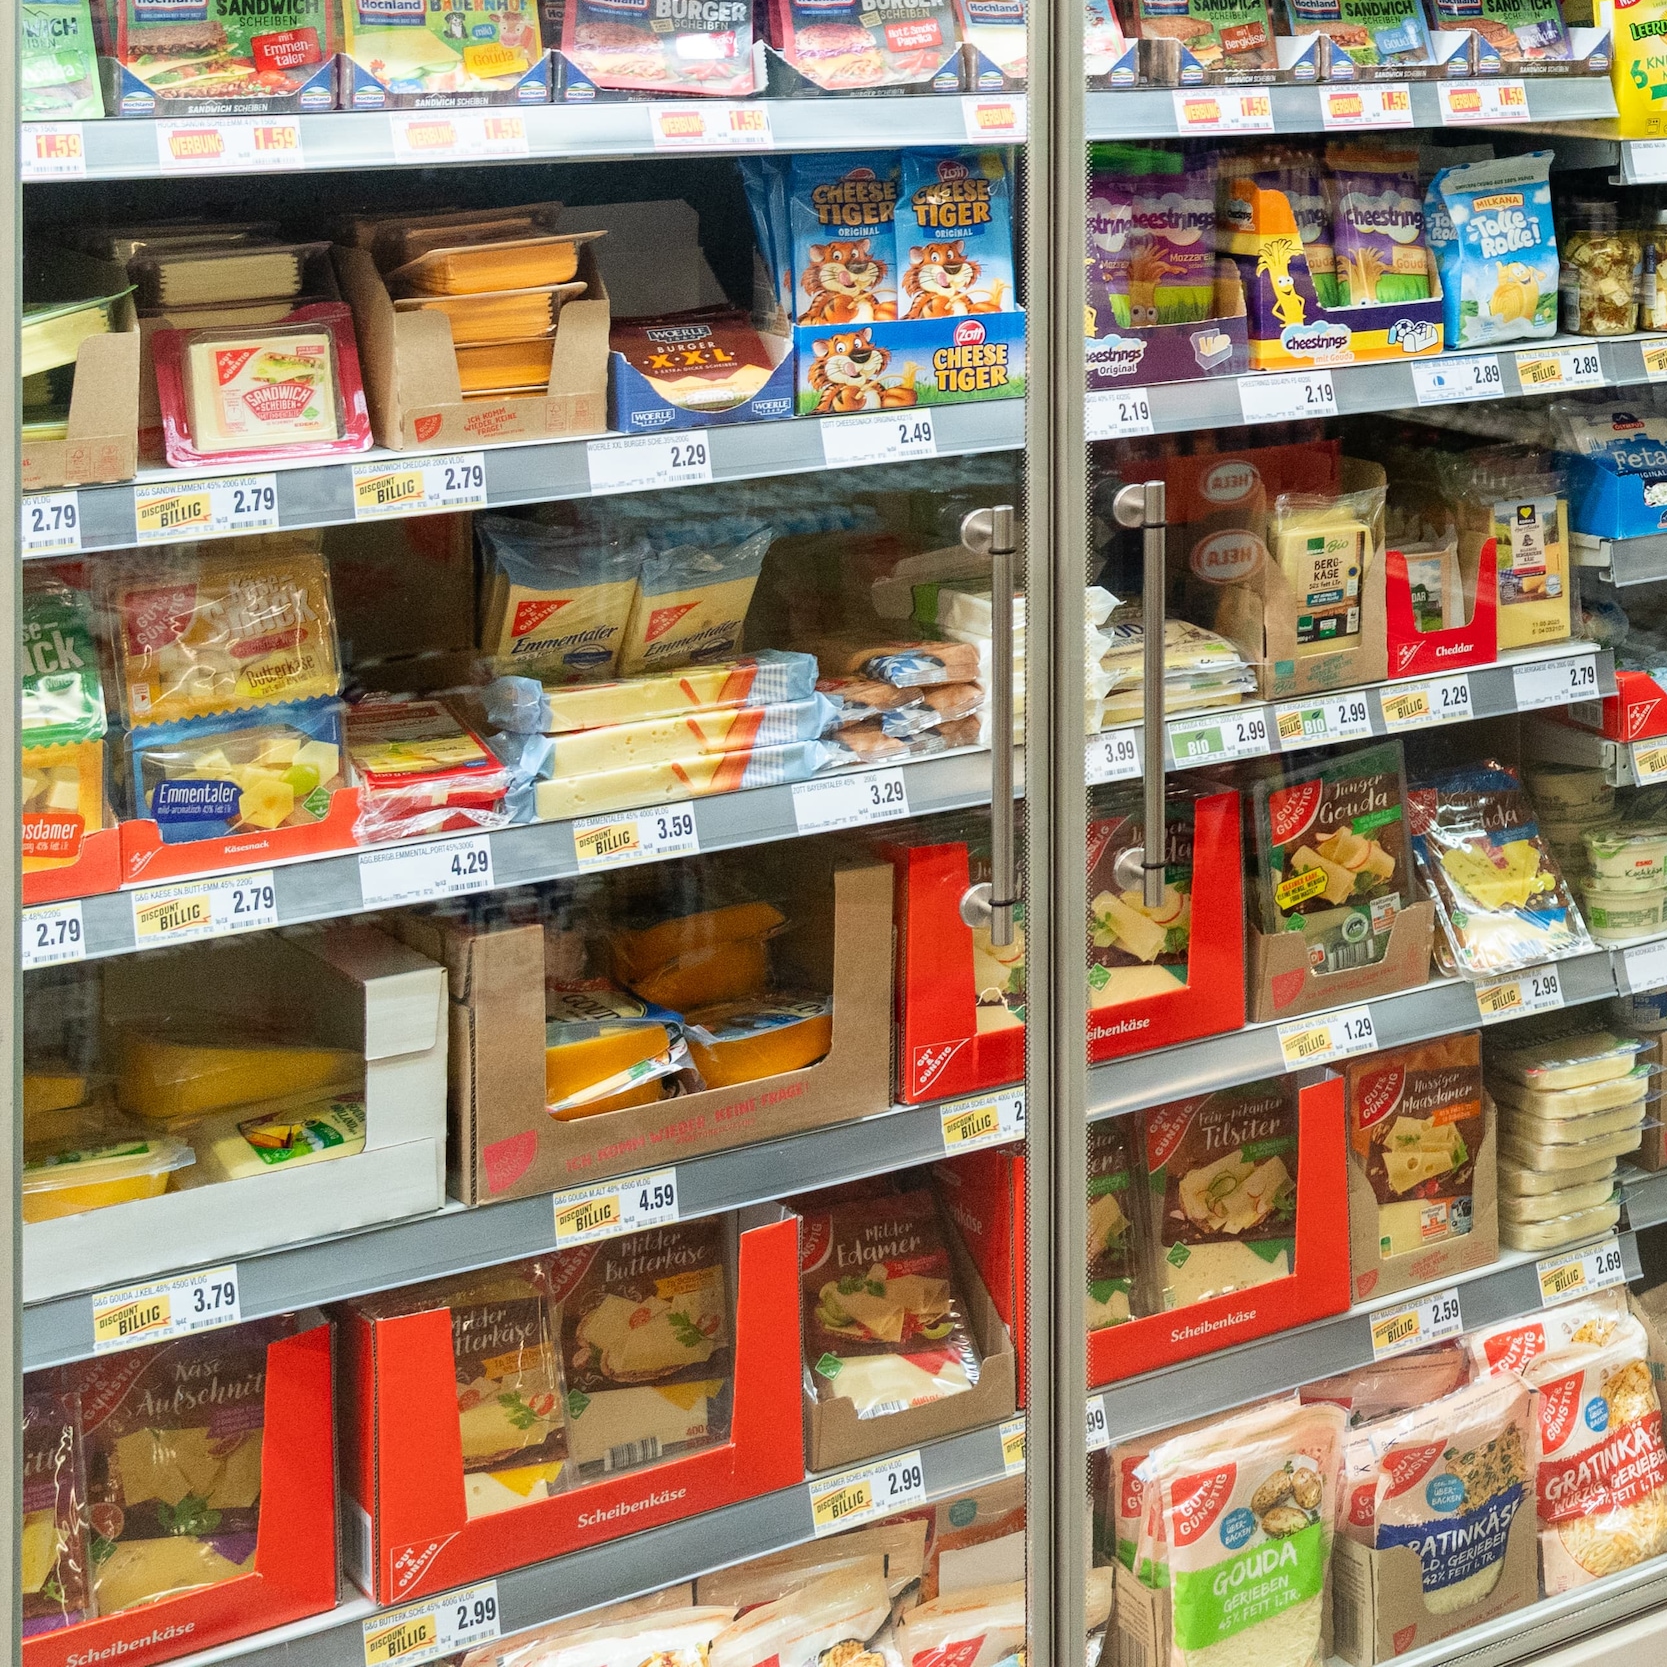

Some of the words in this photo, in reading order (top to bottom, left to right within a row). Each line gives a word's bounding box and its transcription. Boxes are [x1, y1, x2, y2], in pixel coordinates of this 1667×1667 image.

[239, 15, 297, 27] SCHEIBEN
[879, 6, 931, 20] SCHEIBEN
[263, 40, 313, 57] Emmen-
[278, 33, 294, 43] mit
[897, 35, 932, 46] Paprika
[1225, 30, 1265, 52] Bergkäse
[274, 50, 305, 66] taler
[473, 49, 514, 64] Gouda
[1631, 60, 1648, 89] 6
[730, 110, 766, 131] 1.59
[169, 134, 224, 155] WERBUNG
[255, 127, 297, 150] 1.59
[1473, 195, 1521, 210] MILKANA
[652, 327, 707, 339] WOERLE
[658, 342, 716, 352] BURGER
[934, 345, 1009, 370] CHEESE
[1316, 355, 1327, 363] mit
[1328, 350, 1353, 362] Gouda
[934, 366, 1007, 391] TIGER
[1100, 364, 1135, 376] Original
[1474, 365, 1500, 383] 2.89
[1305, 384, 1333, 403] 2.19
[899, 423, 932, 444] 2.49
[671, 445, 706, 468] 2.29
[141, 500, 180, 519] DISCOUNT
[234, 489, 275, 513] 2.79
[160, 501, 202, 528] BILLIG
[1314, 558, 1342, 570] BERG-
[1314, 568, 1339, 580] KÄSE
[512, 625, 618, 654] Emmentaler
[1435, 642, 1473, 658] Cheddar
[1442, 685, 1468, 705] 2.29
[160, 786, 237, 803] Emmentaler
[1334, 775, 1383, 799] Junger
[1319, 792, 1387, 824] Gouda
[657, 815, 693, 839] 3.59
[224, 840, 269, 854] Käsesnack
[451, 850, 488, 875] 4.29
[233, 889, 274, 913] 2.79
[1414, 1073, 1460, 1094] Nussiger
[1402, 1085, 1472, 1112] Maasdamer
[1203, 1117, 1280, 1151] Tilsiter
[639, 1185, 675, 1210] 4.59
[837, 1234, 921, 1266] Edamer
[193, 1283, 235, 1311] 3.79
[1432, 1300, 1459, 1324] 2.59
[1171, 1308, 1256, 1342] Scheibenkäse
[1545, 1425, 1662, 1500] GRATINKÄSE
[888, 1466, 922, 1496] 2.99
[577, 1487, 687, 1529] Scheibenkäse
[1212, 1544, 1298, 1596] GOUDA
[1223, 1574, 1288, 1615] GERIEBEN
